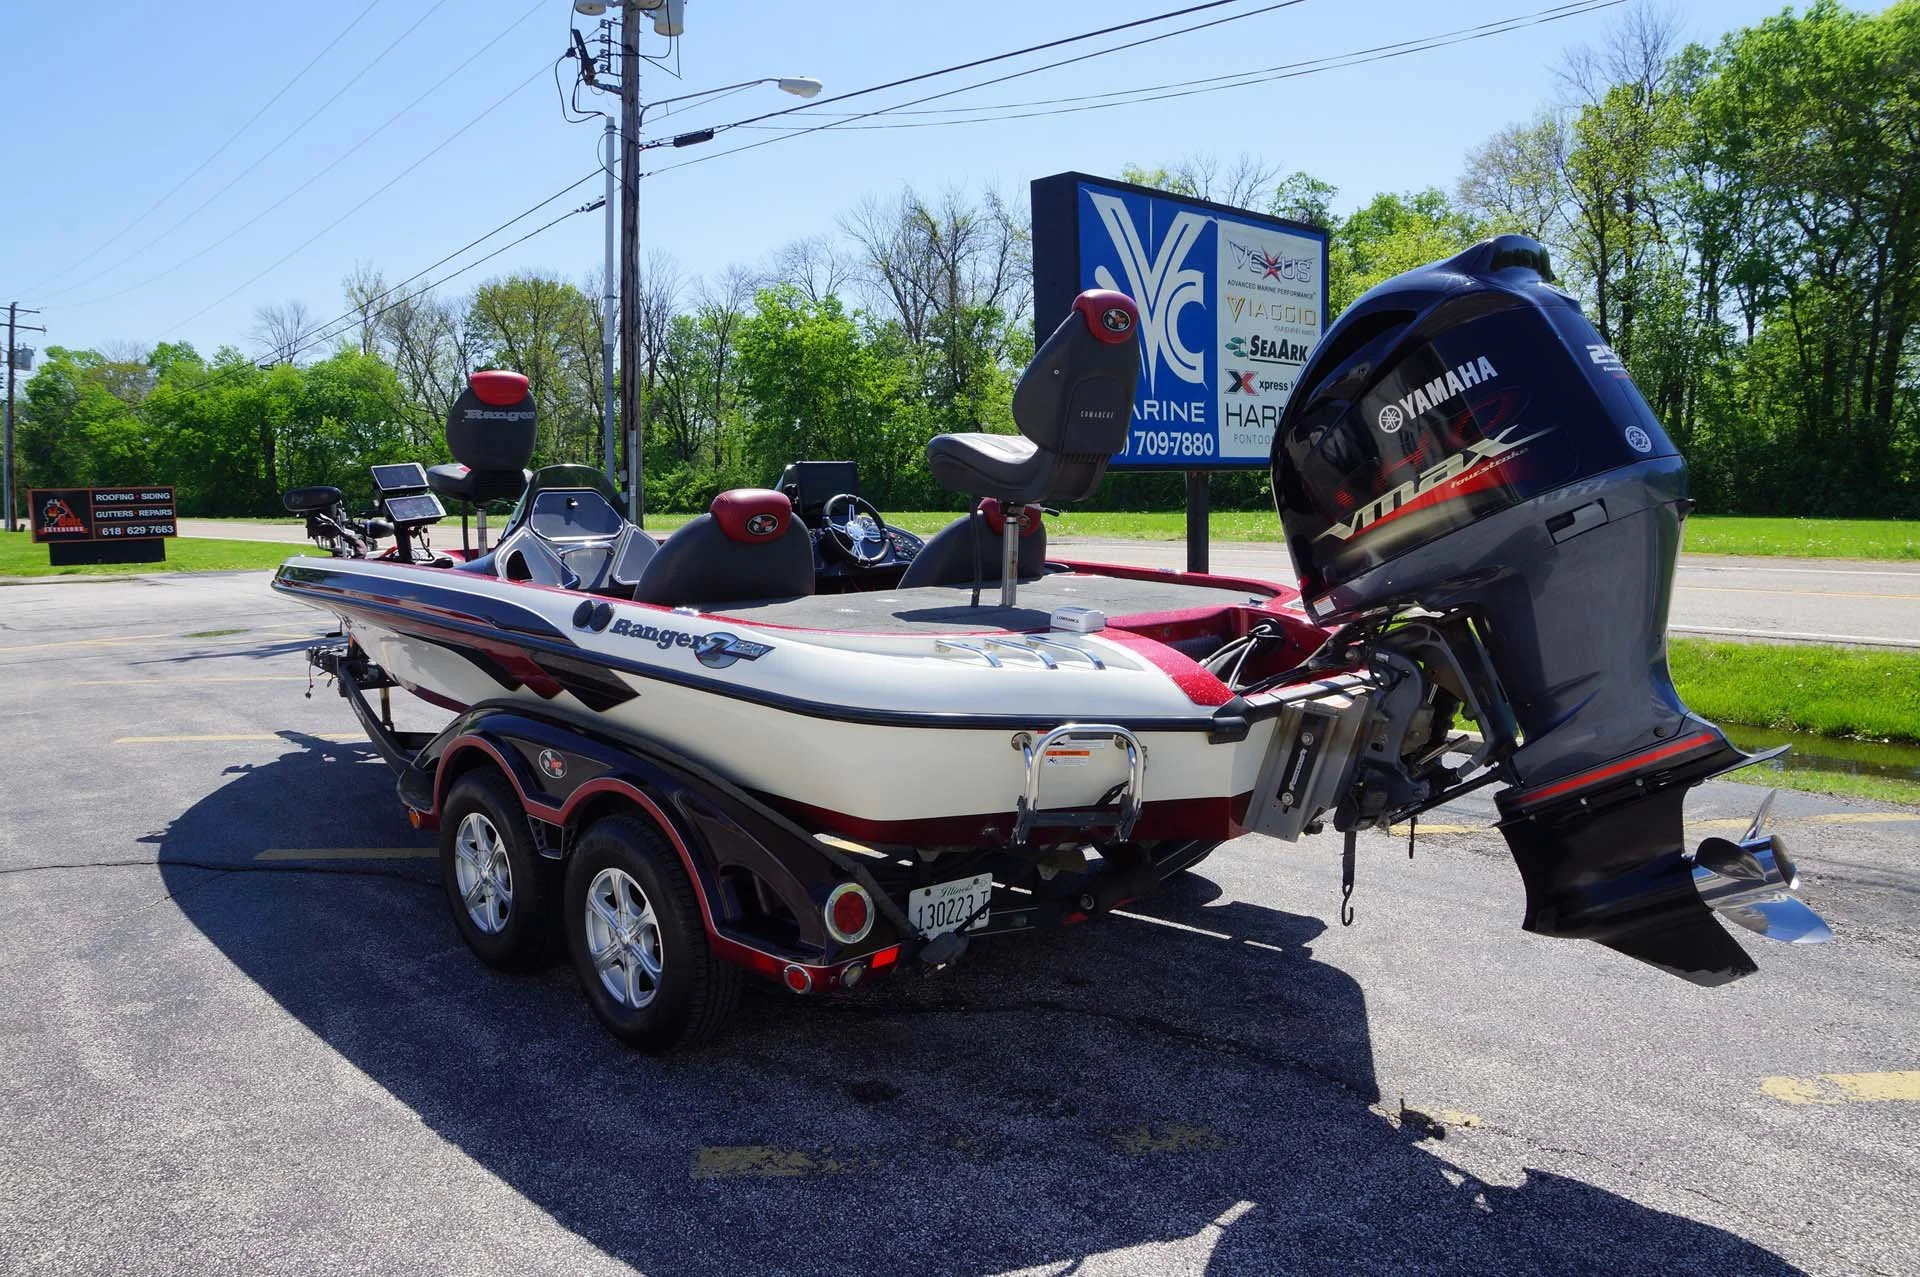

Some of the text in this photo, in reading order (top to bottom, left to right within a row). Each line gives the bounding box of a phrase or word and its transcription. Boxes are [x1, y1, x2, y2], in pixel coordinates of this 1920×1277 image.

[1227, 280, 1314, 300] ADVANCED MARINE PERFORMANCE
[1259, 380, 1288, 392] xpress
[1398, 355, 1499, 420] YAMAHA
[464, 409, 535, 421] Ranger
[1133, 399, 1205, 423] RINE
[1134, 430, 1214, 456] 709-7880
[1234, 433, 1275, 445] PONTOO
[95, 492, 171, 501] ROOFING SIDING
[95, 510, 134, 518] GUTTERS
[609, 618, 708, 650] Ranger
[918, 895, 974, 932] 130223
